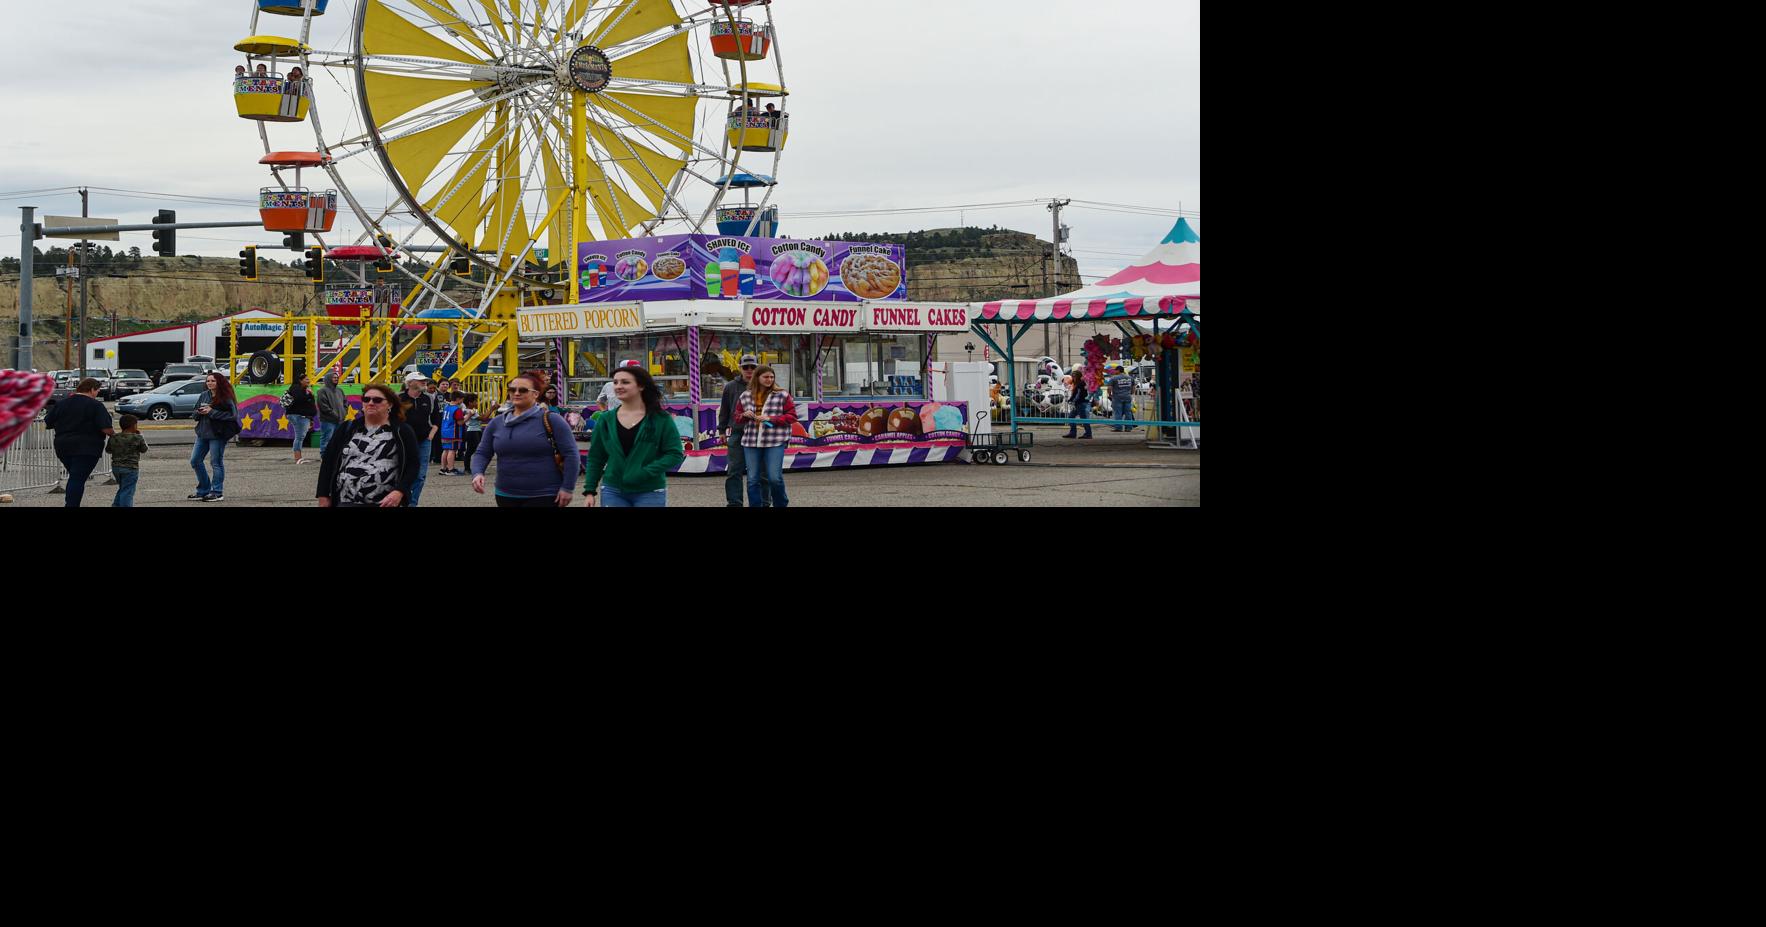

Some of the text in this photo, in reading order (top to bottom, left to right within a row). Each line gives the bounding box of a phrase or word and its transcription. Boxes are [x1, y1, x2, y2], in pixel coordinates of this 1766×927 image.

[706, 239, 751, 253] SHAVED ICE
[772, 242, 826, 258] Cotton Candy
[849, 246, 891, 255] Funnel Cake
[520, 308, 640, 332] BUTTERED POPCORN
[752, 308, 857, 327] COTTON CANDY
[873, 308, 966, 326] FUNNEL CAKES
